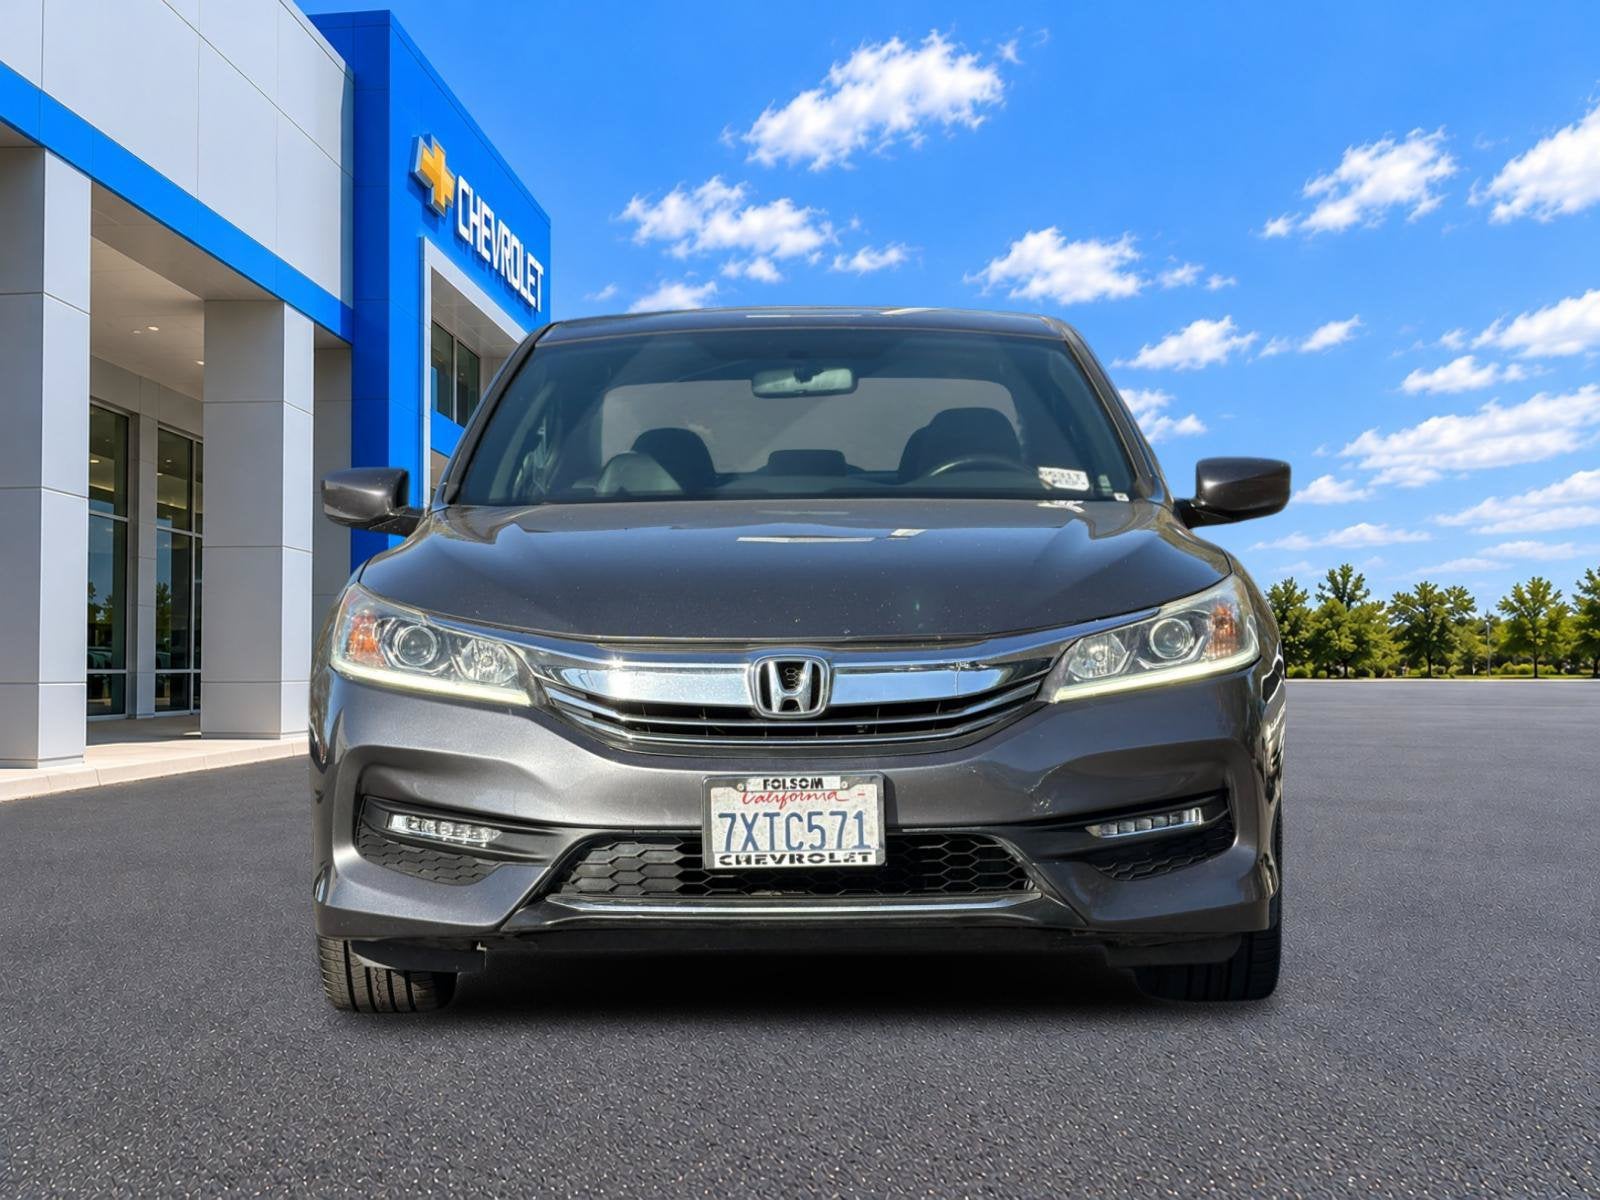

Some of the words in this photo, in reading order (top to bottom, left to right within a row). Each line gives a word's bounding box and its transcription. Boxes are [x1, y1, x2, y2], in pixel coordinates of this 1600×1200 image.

[458, 175, 544, 312] CHEVROLET
[767, 660, 813, 713] H
[763, 778, 824, 790] FOLSOM
[742, 790, 849, 810] California
[718, 811, 871, 852] 7XTC571
[719, 852, 872, 865] CHEVROLET
